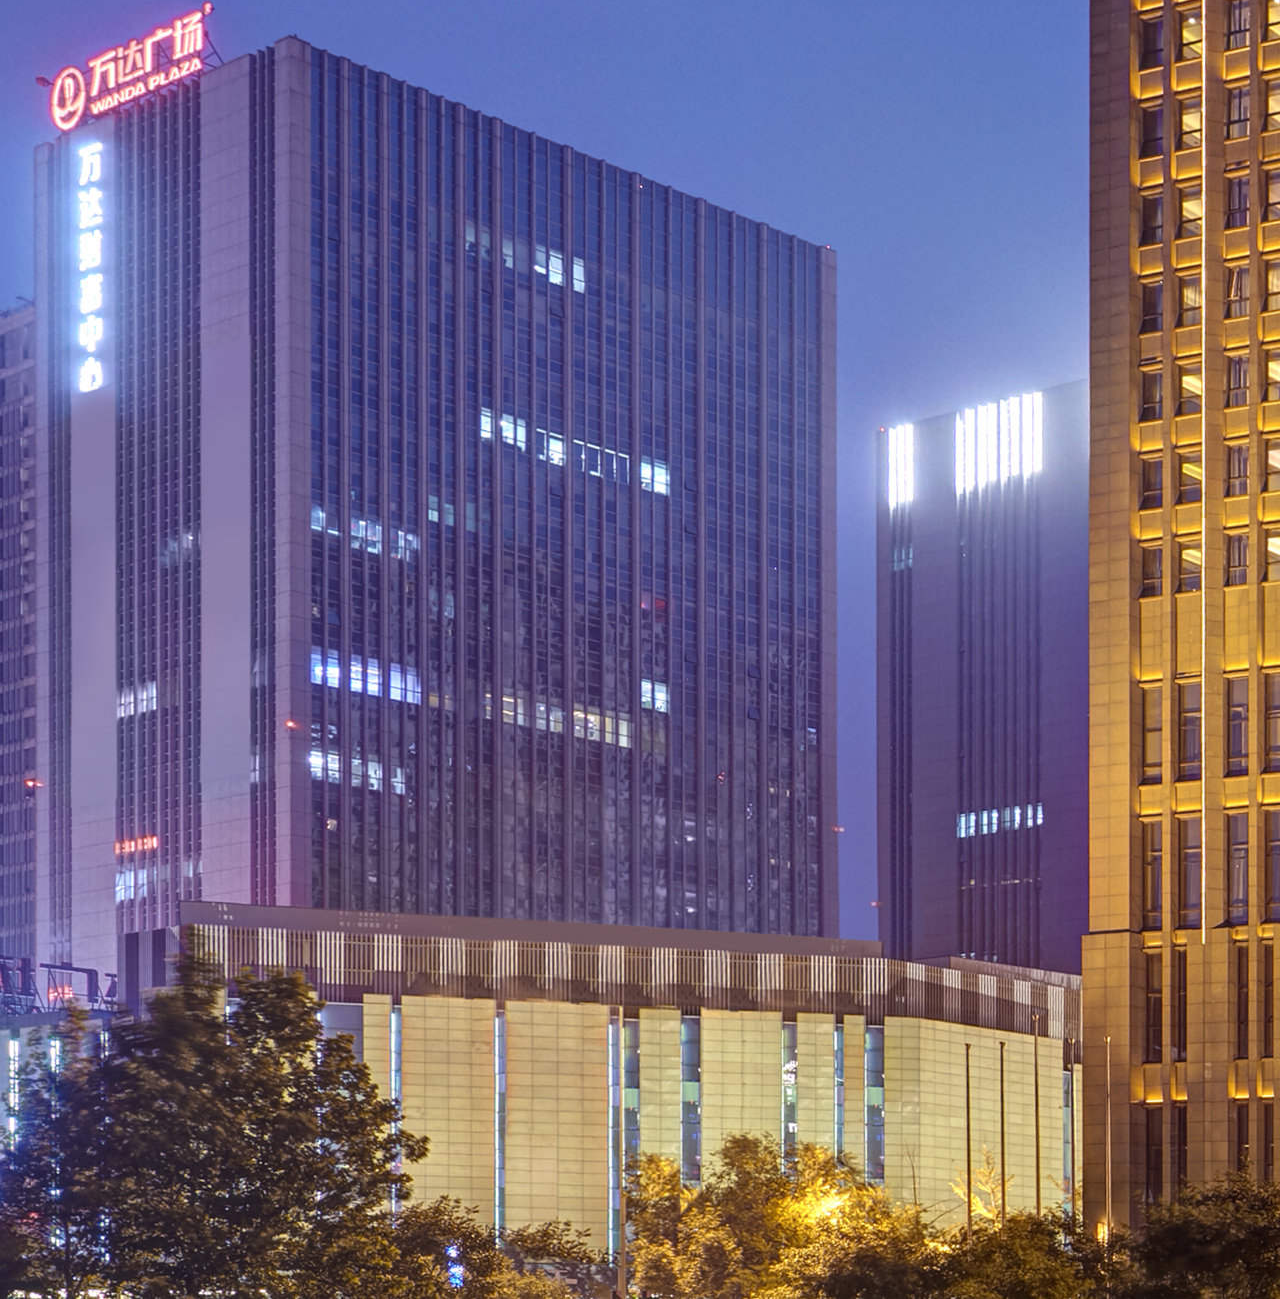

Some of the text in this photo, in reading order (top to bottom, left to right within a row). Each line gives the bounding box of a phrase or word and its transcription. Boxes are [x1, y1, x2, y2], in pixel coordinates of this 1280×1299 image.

[89, 11, 203, 97] 万达广场
[91, 57, 203, 115] WANDA PLAZA
